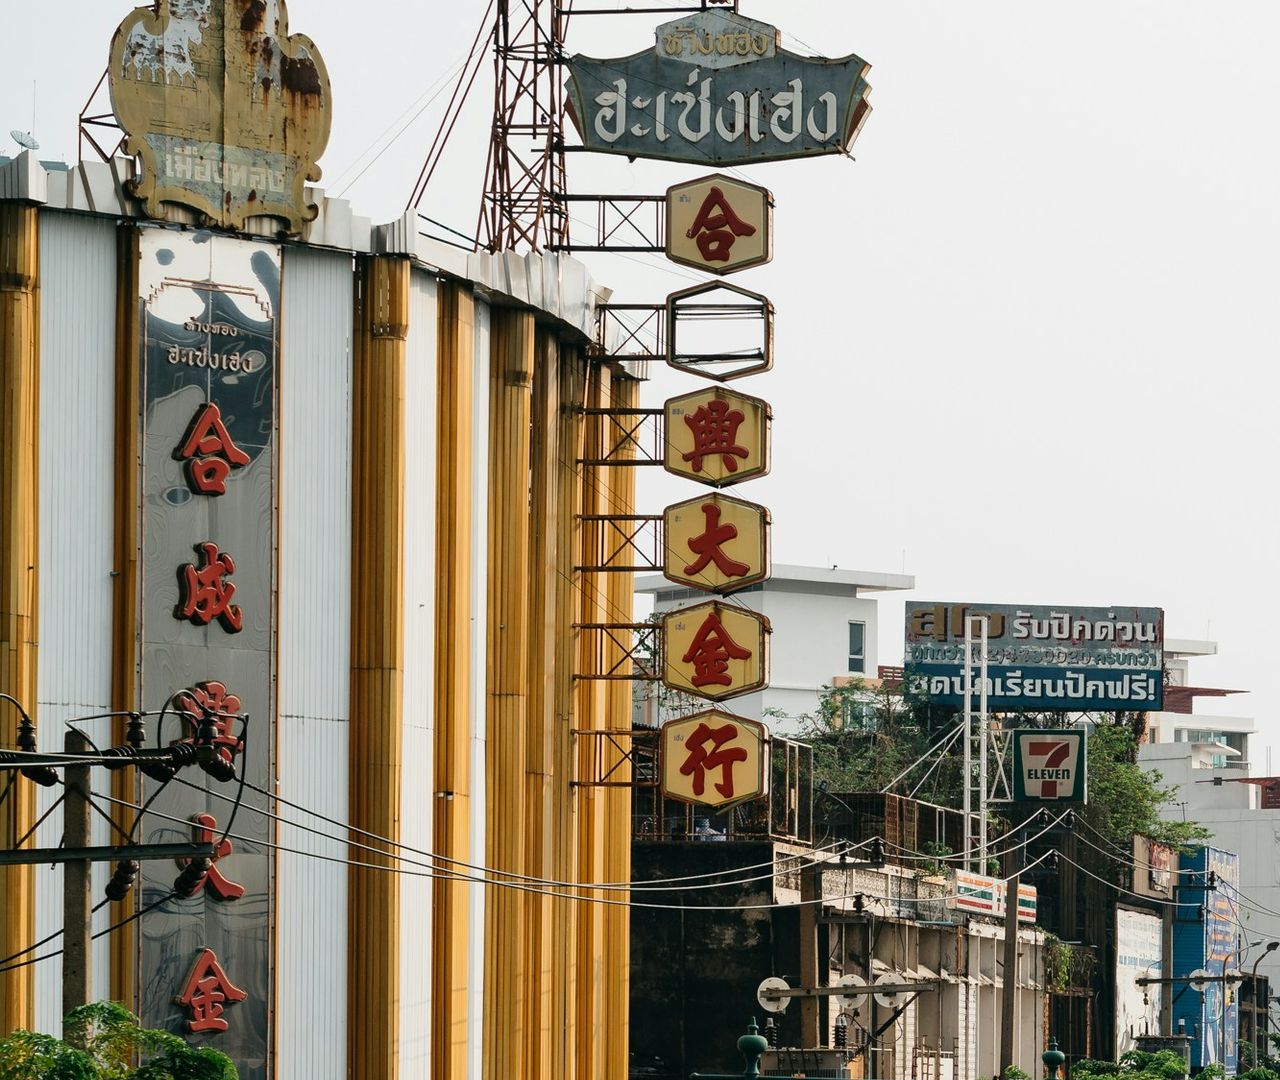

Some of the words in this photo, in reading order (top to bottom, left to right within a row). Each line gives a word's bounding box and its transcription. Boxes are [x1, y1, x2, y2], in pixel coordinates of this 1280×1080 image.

[664, 26, 768, 56] ห้างทอง
[594, 68, 838, 143] ฮะเซ่งเฮง
[686, 186, 757, 261] 合
[167, 344, 253, 373] ฮะเซ่งเฮง
[682, 399, 750, 473] 興
[684, 502, 750, 578] 大
[682, 611, 752, 687] 金
[680, 722, 748, 799] 行
